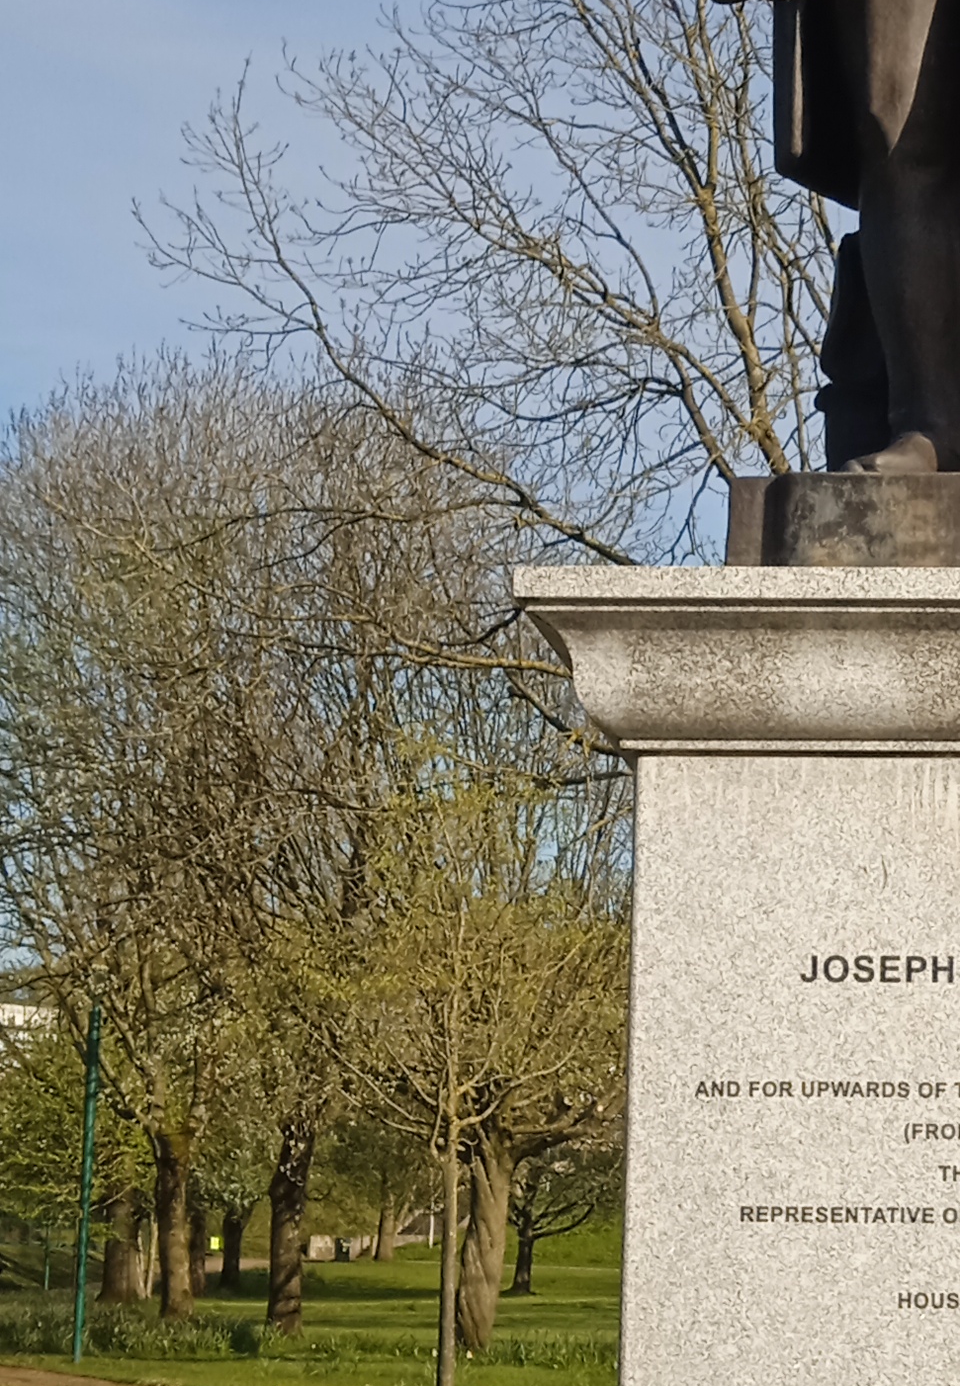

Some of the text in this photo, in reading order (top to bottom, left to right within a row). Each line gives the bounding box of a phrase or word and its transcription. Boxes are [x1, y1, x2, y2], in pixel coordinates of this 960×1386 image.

[800, 955, 955, 984] JOSEPH
[695, 1080, 742, 1098] AND
[749, 1081, 793, 1098] FOR
[801, 1082, 911, 1099] UPWARDS
[918, 1082, 948, 1099] OF
[740, 1206, 935, 1224] REPRESENTATIVE
